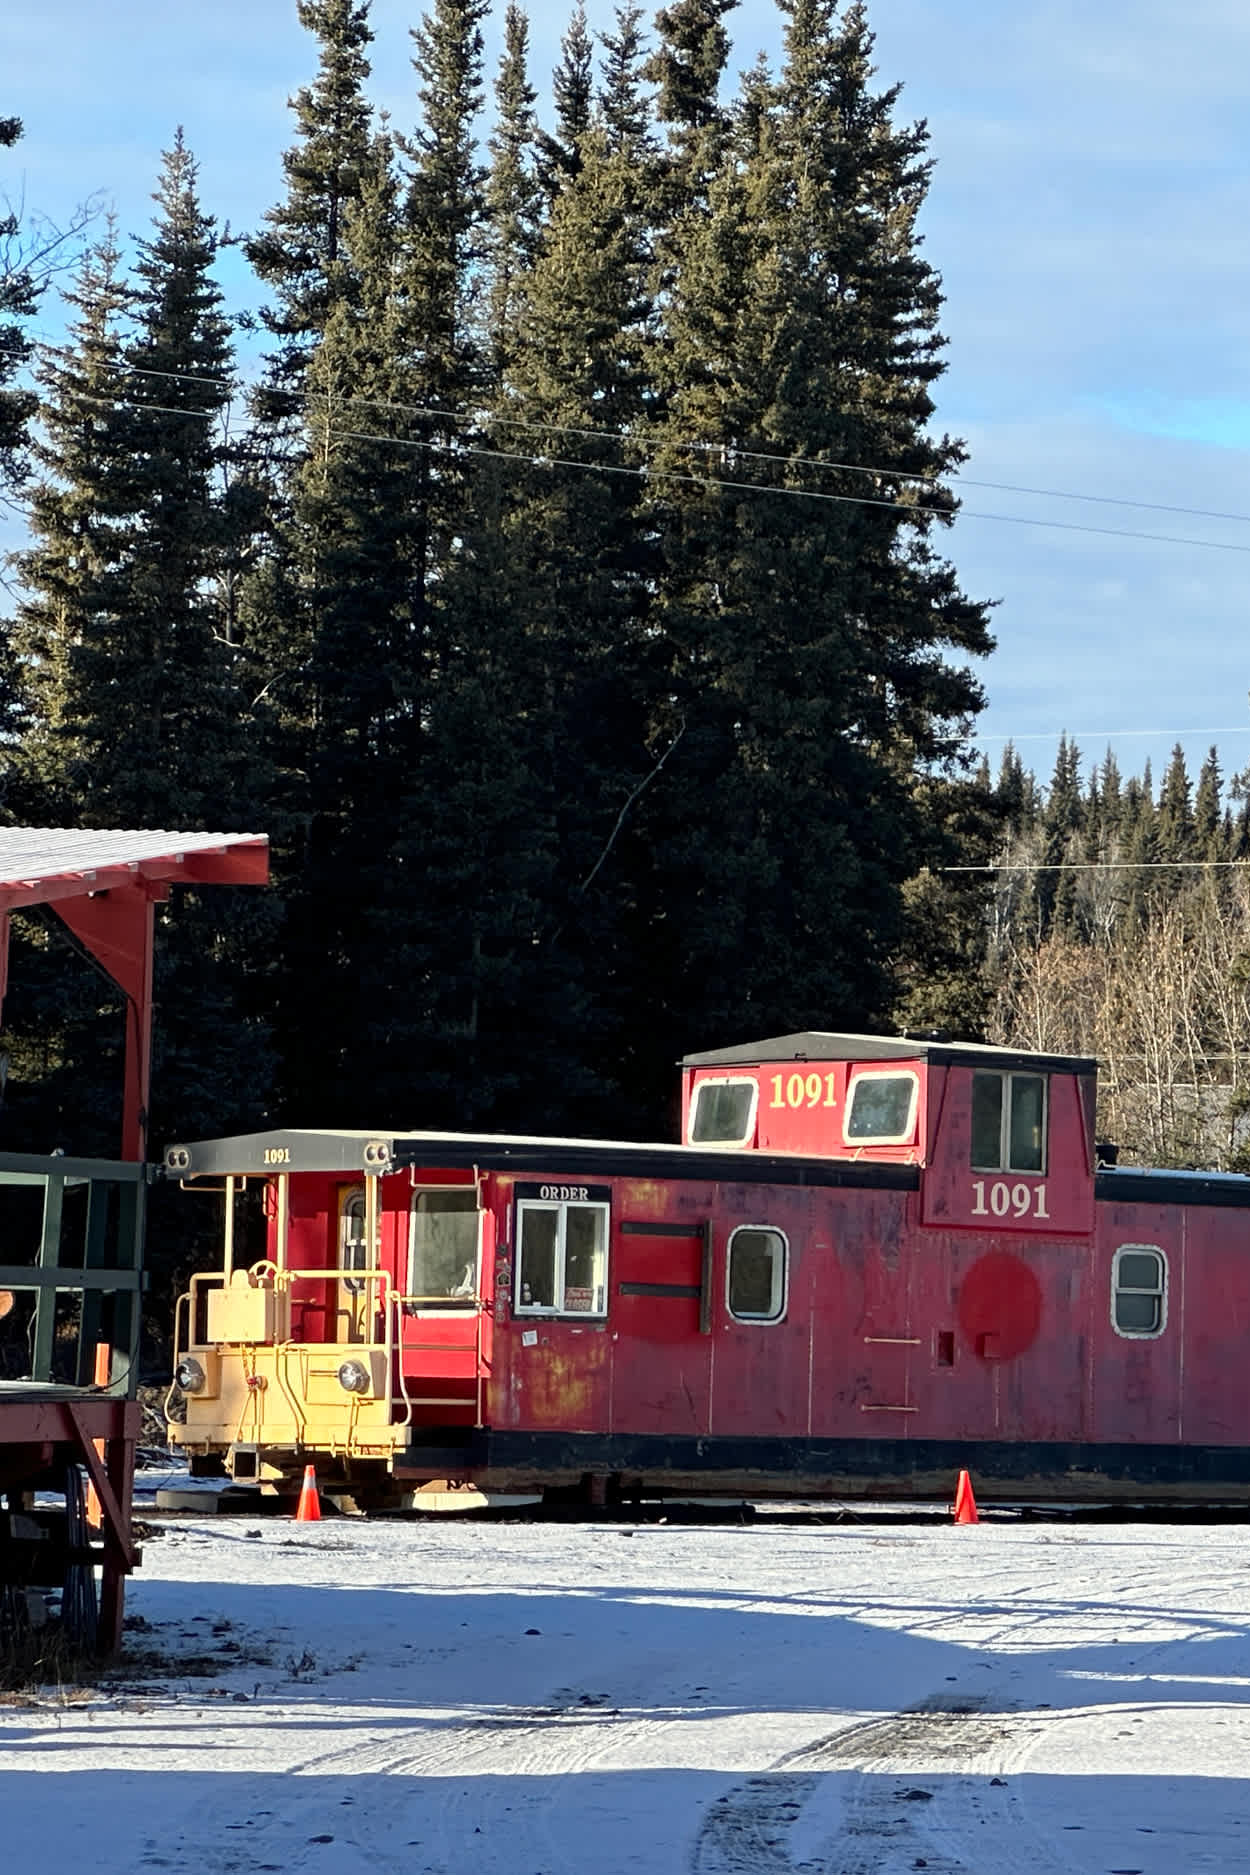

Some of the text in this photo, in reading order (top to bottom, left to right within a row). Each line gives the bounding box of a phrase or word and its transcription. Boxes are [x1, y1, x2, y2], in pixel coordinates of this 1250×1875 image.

[769, 1073, 837, 1108] 1091
[264, 1148, 290, 1163] 1091
[540, 1185, 588, 1200] ORDER
[970, 1181, 1050, 1219] 1091
